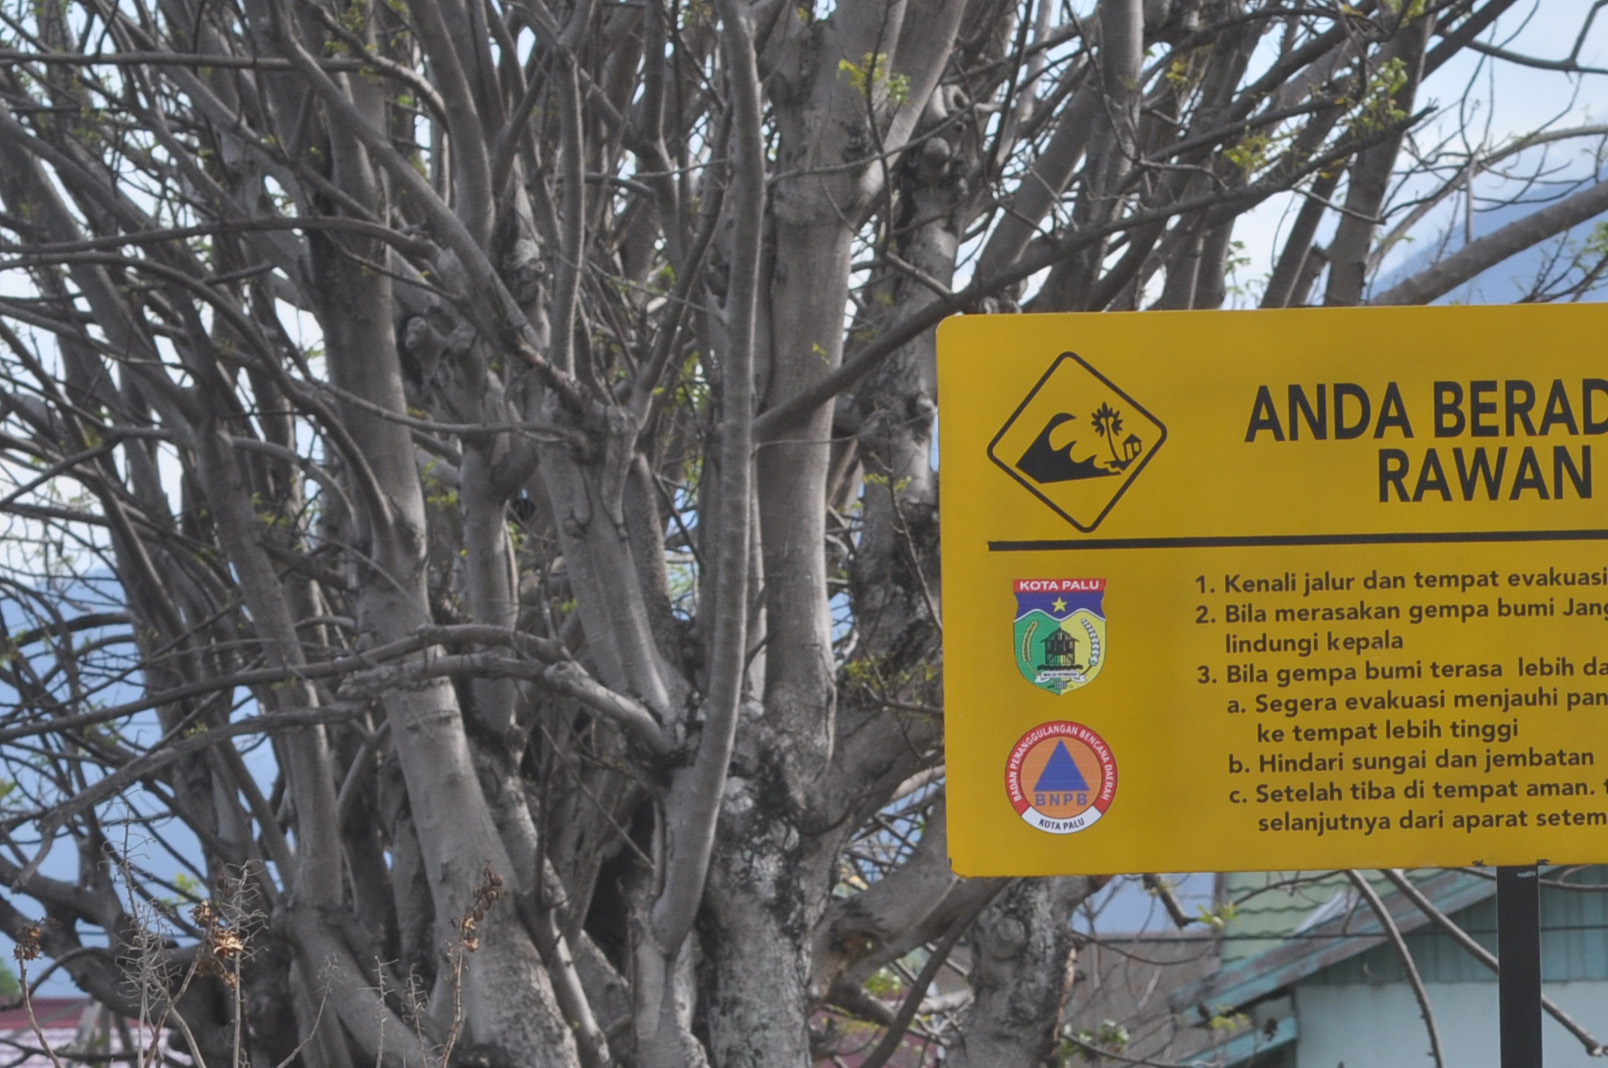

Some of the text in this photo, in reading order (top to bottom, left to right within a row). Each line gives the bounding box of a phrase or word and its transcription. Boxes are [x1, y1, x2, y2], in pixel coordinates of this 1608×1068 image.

[1244, 381, 1414, 443] ANDA
[1378, 444, 1592, 503] RAWAN
[1020, 580, 1099, 591] KOTA PALU
[1195, 574, 1215, 594] 1.
[1224, 571, 1297, 594] Kenali
[1303, 570, 1356, 598] jalur
[1362, 569, 1406, 590] dan
[1413, 570, 1499, 593] tempat
[1507, 566, 1608, 587] evakuasi
[1195, 604, 1216, 624] 2.
[1225, 602, 1267, 624] Bila
[1275, 600, 1401, 622] merasakan
[1408, 603, 1489, 625] gempa
[1497, 597, 1555, 617] bumi
[1225, 629, 1404, 658] lindungi kepala
[1197, 665, 1217, 684] 3.
[1226, 662, 1269, 684] Bila
[1276, 667, 1357, 688] gempa
[1365, 660, 1422, 680] bumi
[1429, 661, 1503, 679] terasa
[1518, 656, 1575, 677] lebih
[1226, 700, 1246, 714] a.
[1255, 693, 1337, 718] Segera
[1345, 689, 1445, 711] evakuasi
[1453, 686, 1558, 713] menjauhi
[1257, 717, 1518, 747] ke tempat lebih tinggi
[1009, 725, 1114, 802] BADAN PENANGGULANGAN BENCANA DAERAH
[1228, 746, 1595, 776] b. Hindari sungai dan jembatan
[1035, 793, 1088, 806] BNPB
[1229, 790, 1248, 804] c.
[1255, 781, 1343, 804] Setelah
[1349, 779, 1396, 801] tiba
[1403, 778, 1425, 799] di
[1432, 780, 1519, 804] tempat
[1526, 782, 1595, 797] aman.
[1039, 818, 1085, 830] KOTA PALU
[1258, 811, 1391, 837] selanjutnya
[1399, 809, 1444, 830] dari
[1452, 810, 1528, 834] aparat
